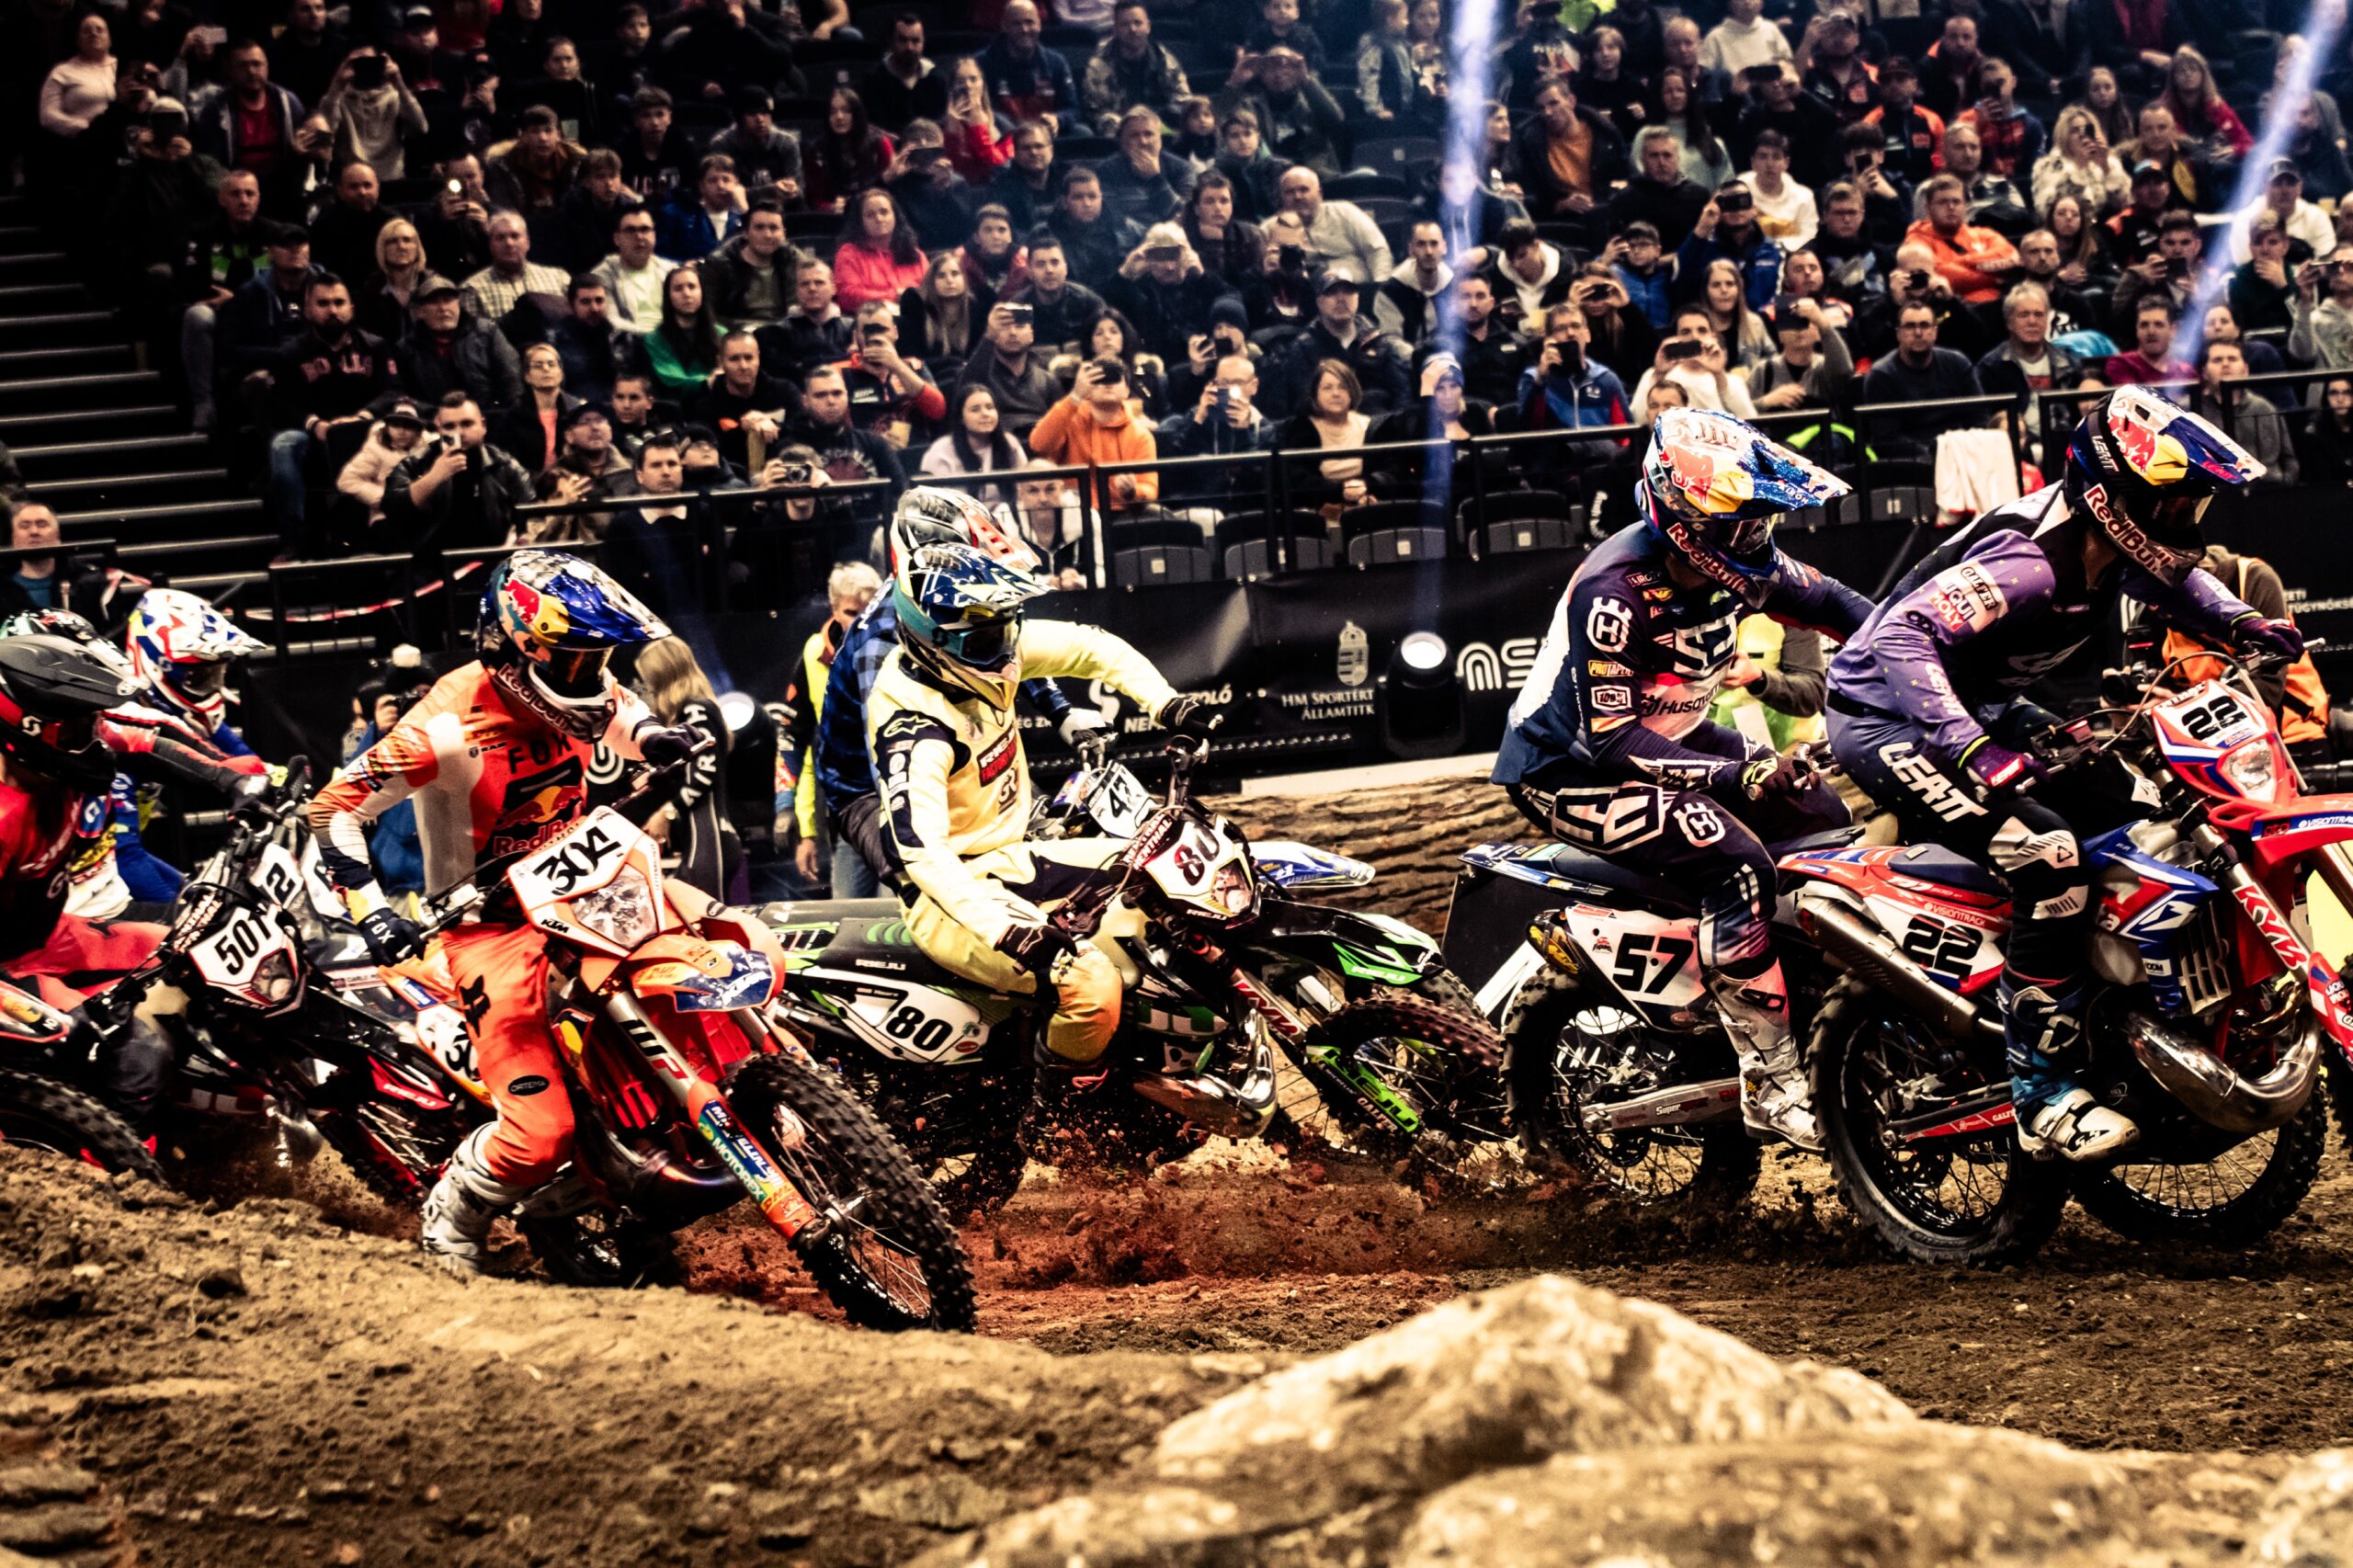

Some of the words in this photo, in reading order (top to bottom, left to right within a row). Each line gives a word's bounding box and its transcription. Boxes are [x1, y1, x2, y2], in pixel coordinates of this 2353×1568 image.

[1281, 694, 1309, 708] HM
[2181, 695, 2247, 741] 22
[508, 733, 572, 774] FOX
[533, 825, 622, 896] 304
[1175, 823, 1221, 887] 80
[213, 905, 273, 976] 501
[361, 915, 396, 945] FOX
[540, 918, 570, 934] KTM
[1903, 913, 1984, 978] 22
[2234, 882, 2307, 971] KYB
[1613, 932, 1694, 995] 57
[885, 1005, 954, 1052] 80
[711, 1136, 767, 1202] MOTOREX
